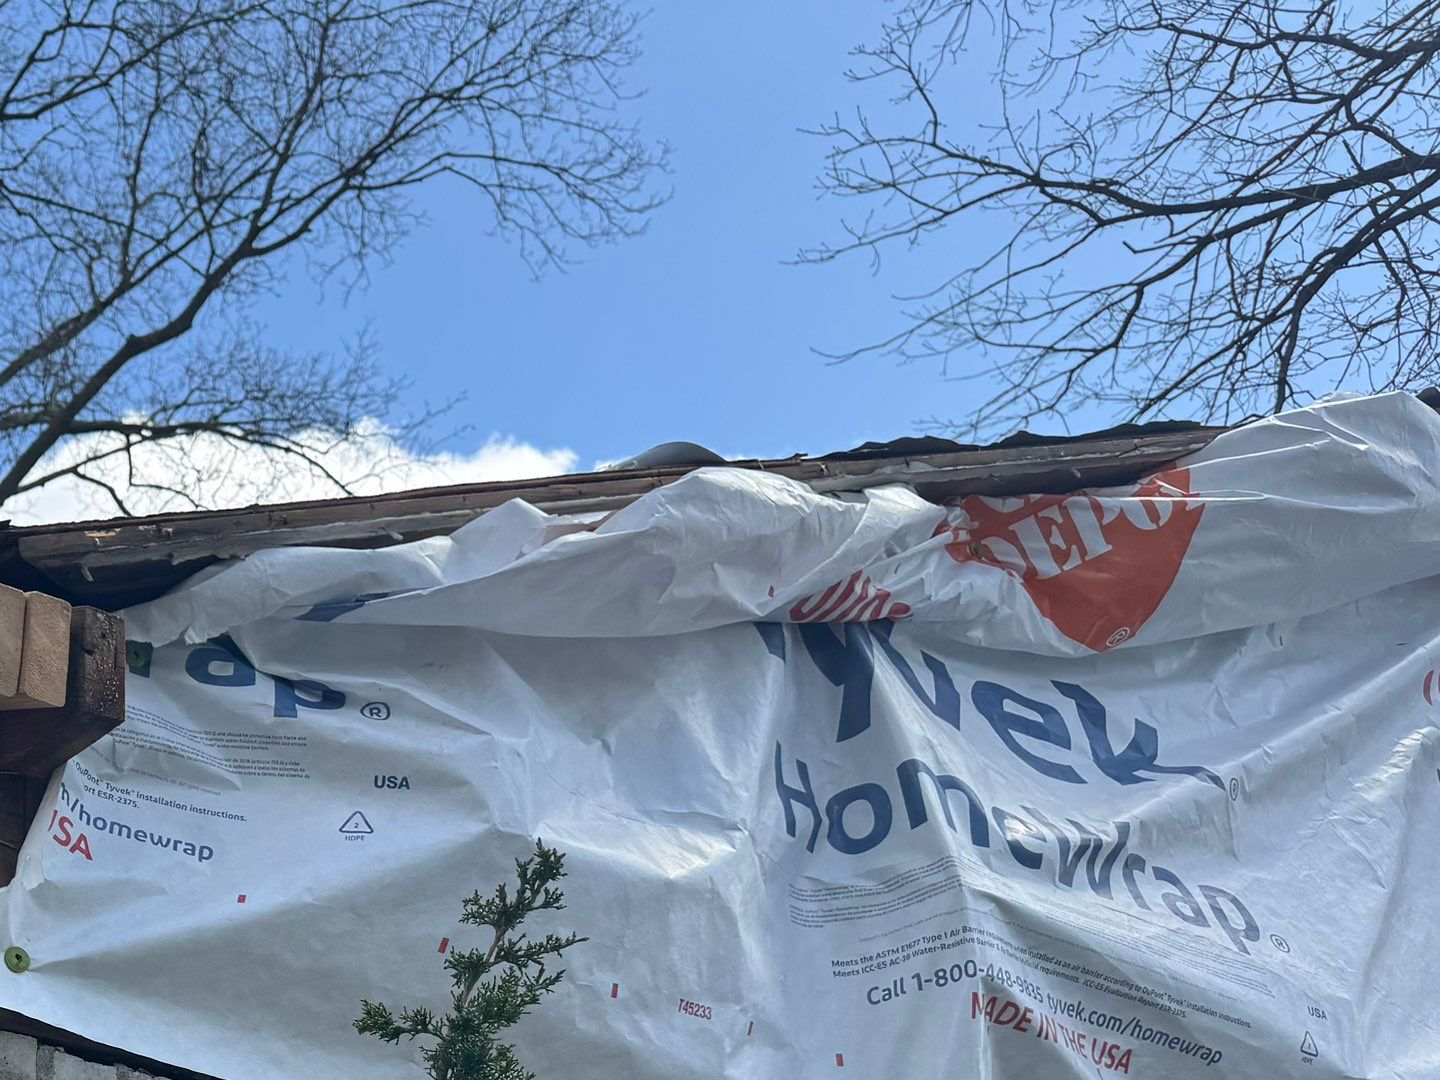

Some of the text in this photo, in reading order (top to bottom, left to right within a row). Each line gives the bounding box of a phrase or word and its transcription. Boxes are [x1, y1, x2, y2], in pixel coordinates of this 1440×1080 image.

[97, 787, 140, 810] ESR-2375.
[374, 775, 411, 790] USA
[136, 790, 187, 811] installation
[189, 803, 248, 822] instructions.
[344, 834, 365, 842] HDPE
[775, 743, 1261, 956] HomeWrap
[831, 957, 859, 968] Meets
[859, 954, 874, 964] the
[874, 947, 900, 960] ASTM
[921, 932, 943, 945] Type
[949, 928, 961, 939] Air
[1054, 958, 1062, 966] as
[1062, 960, 1071, 969] an
[1071, 962, 1081, 971] air
[1082, 965, 1104, 980] barrier
[1103, 974, 1135, 992] according
[1134, 984, 1142, 993] to
[1186, 999, 1218, 1018] installation
[1218, 1010, 1252, 1028] instructions.
[832, 969, 860, 978] Meets
[861, 961, 888, 975] ICC-ES
[911, 935, 976, 957] Water-Resistive
[1039, 966, 1080, 984] requirements.
[1103, 985, 1138, 1002] Evaluation
[1138, 997, 1160, 1011] Report
[678, 998, 712, 1020] T45233
[866, 959, 1224, 1067] Call 1-800-448-9835 tyvek.com/homewrap
[1307, 1005, 1328, 1021] USA
[1036, 1013, 1059, 1045] IN
[1057, 1023, 1088, 1060] THE
[1091, 1038, 1135, 1075] USA
